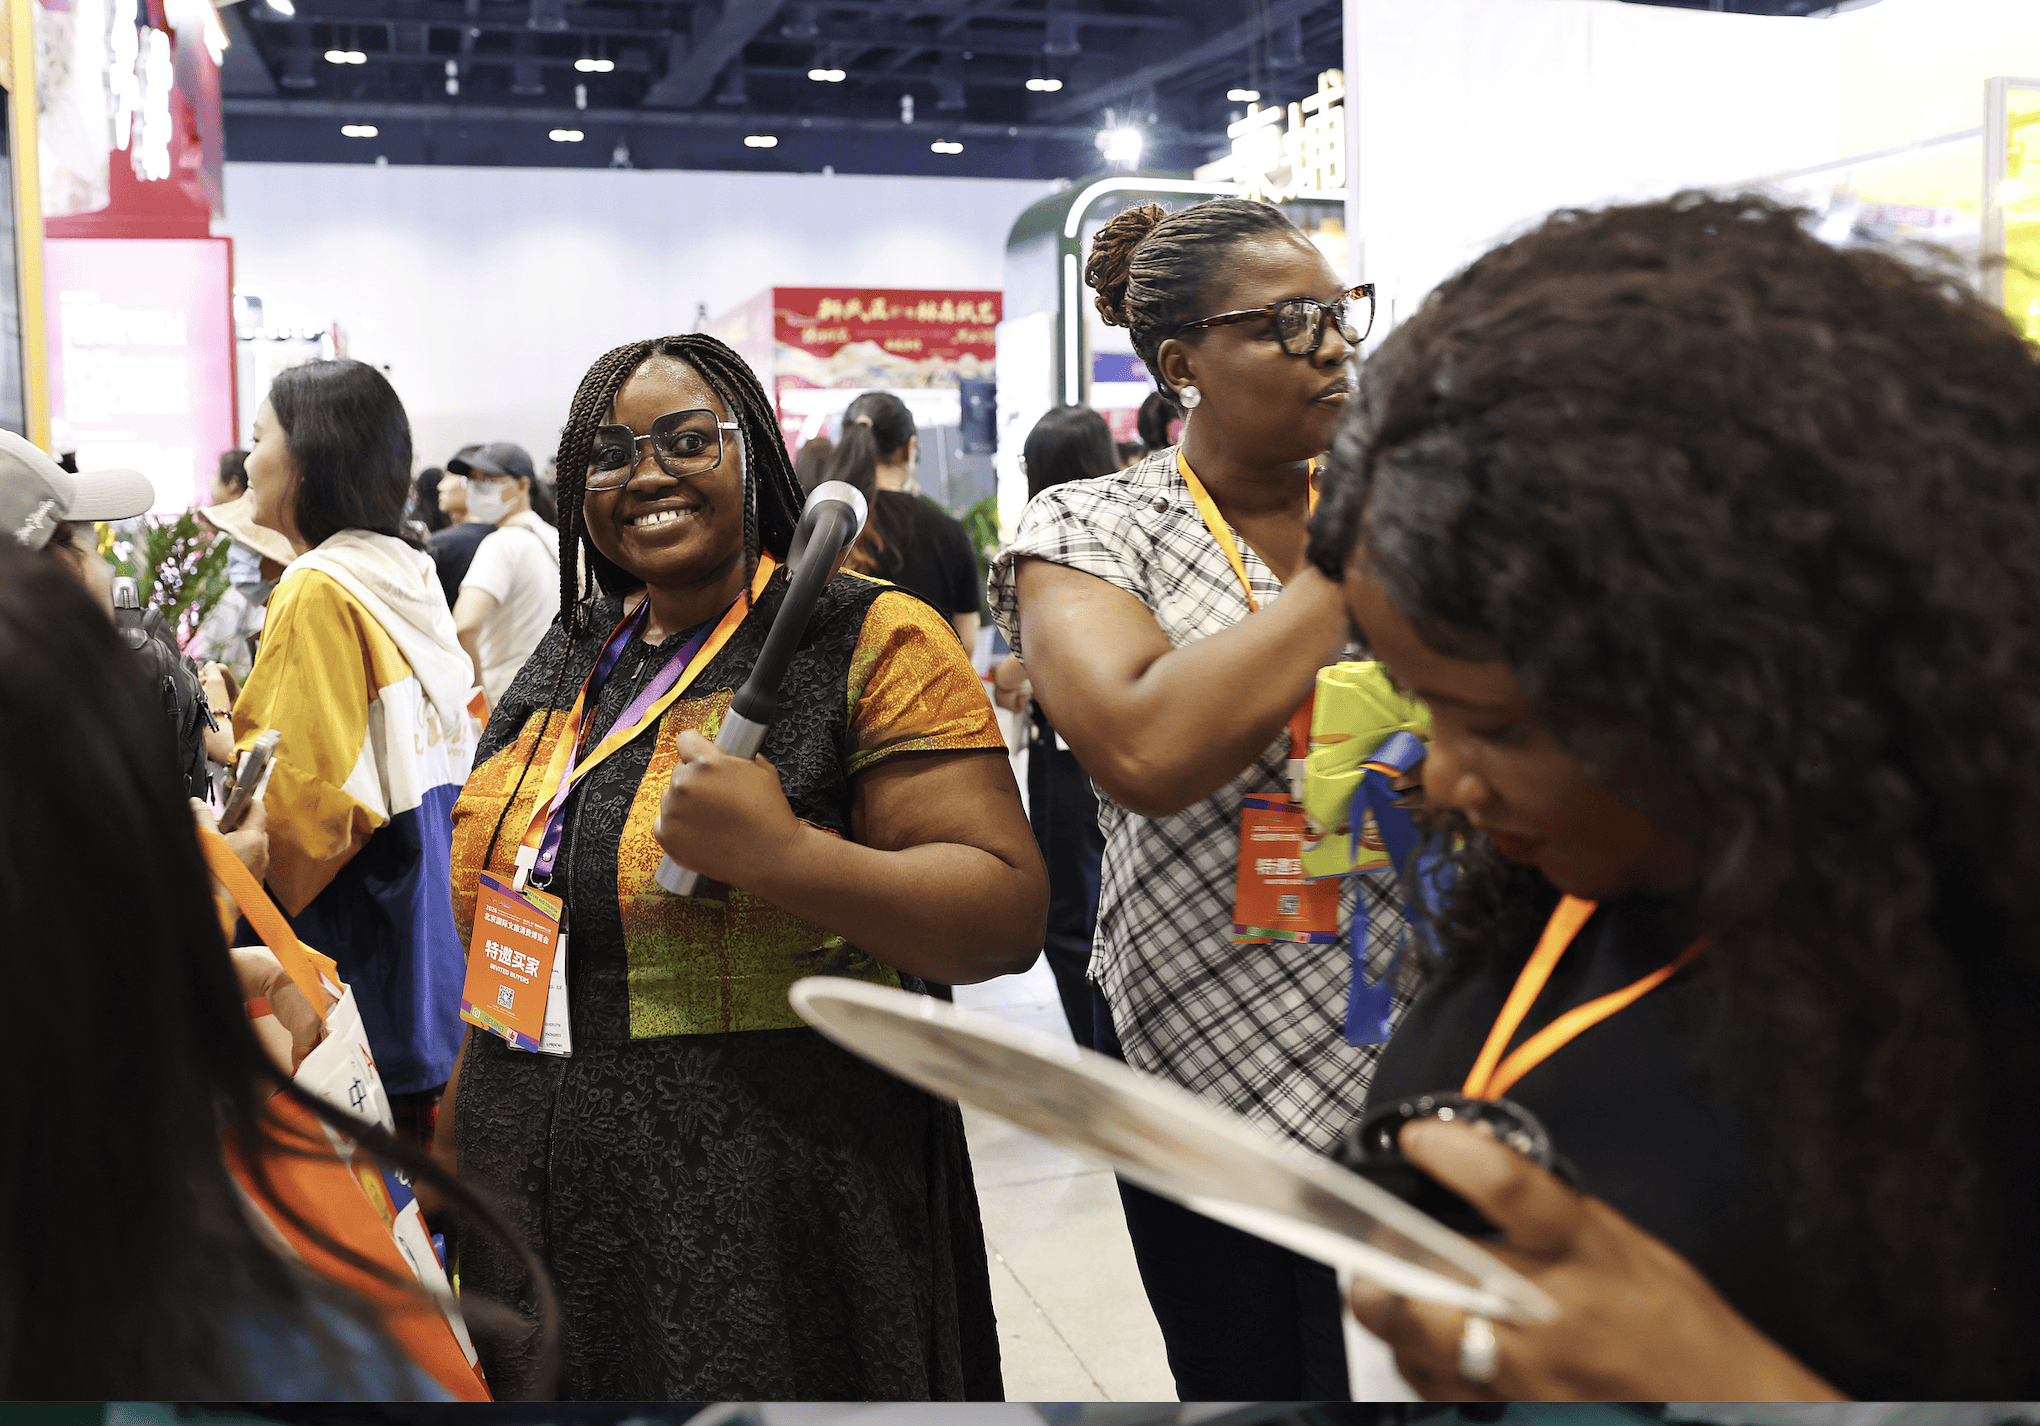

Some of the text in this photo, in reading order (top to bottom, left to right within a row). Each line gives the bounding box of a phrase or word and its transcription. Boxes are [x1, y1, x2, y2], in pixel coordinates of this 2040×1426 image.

[485, 939, 540, 978] 特邀买家
[509, 971, 530, 985] BUYERS
